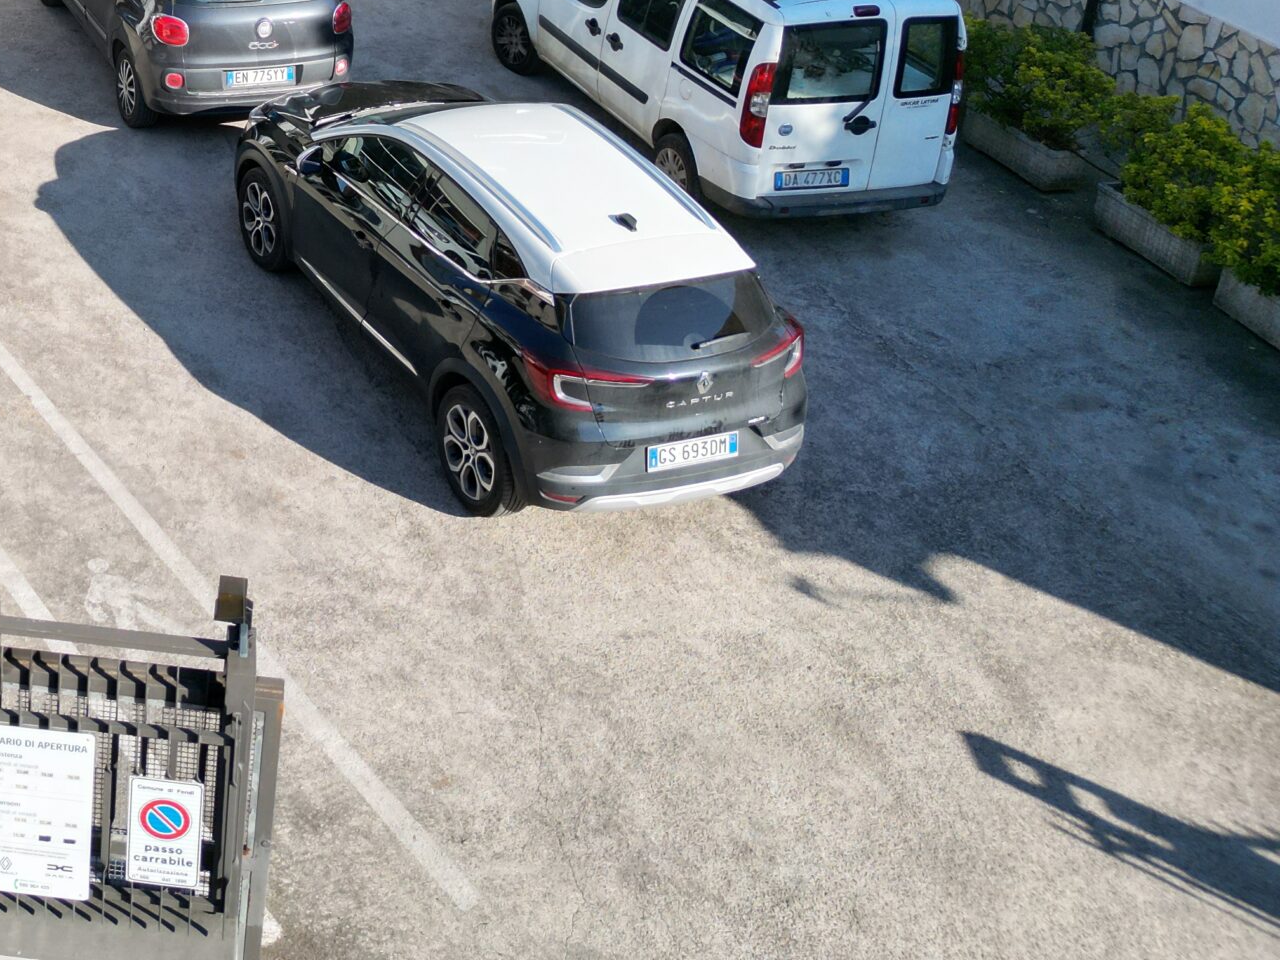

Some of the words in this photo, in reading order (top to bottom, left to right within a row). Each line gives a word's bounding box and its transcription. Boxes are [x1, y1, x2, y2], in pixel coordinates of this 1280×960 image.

[235, 71, 249, 83] EN
[252, 69, 286, 82] 775YY
[784, 174, 799, 187] DA
[803, 170, 841, 185] 477XC
[665, 390, 734, 409] CAPTUR
[658, 447, 676, 465] GS
[682, 438, 727, 461] 693DM
[24, 739, 35, 748] DI
[37, 741, 88, 753] APERTURA
[144, 844, 183, 855] passo
[133, 854, 193, 867] carrabile
